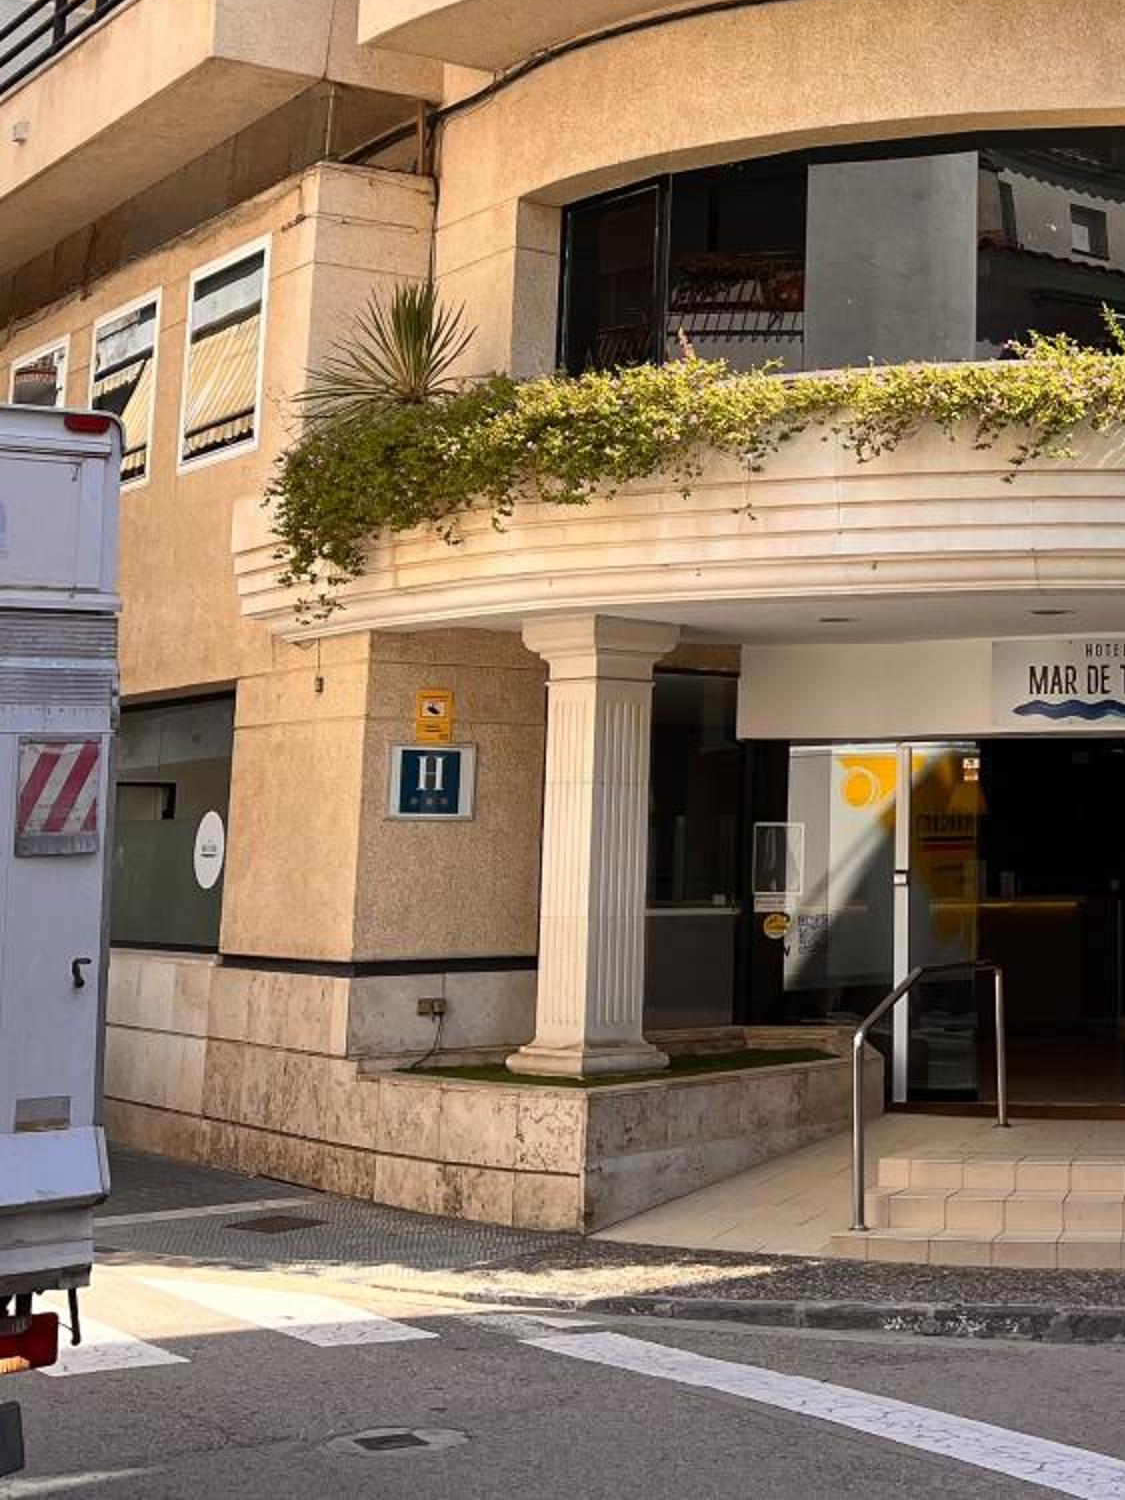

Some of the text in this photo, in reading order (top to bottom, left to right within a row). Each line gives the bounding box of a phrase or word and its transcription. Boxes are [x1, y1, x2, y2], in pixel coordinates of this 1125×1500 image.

[1028, 665, 1077, 695] MAR
[1087, 665, 1111, 695] DE
[415, 755, 446, 791] H
